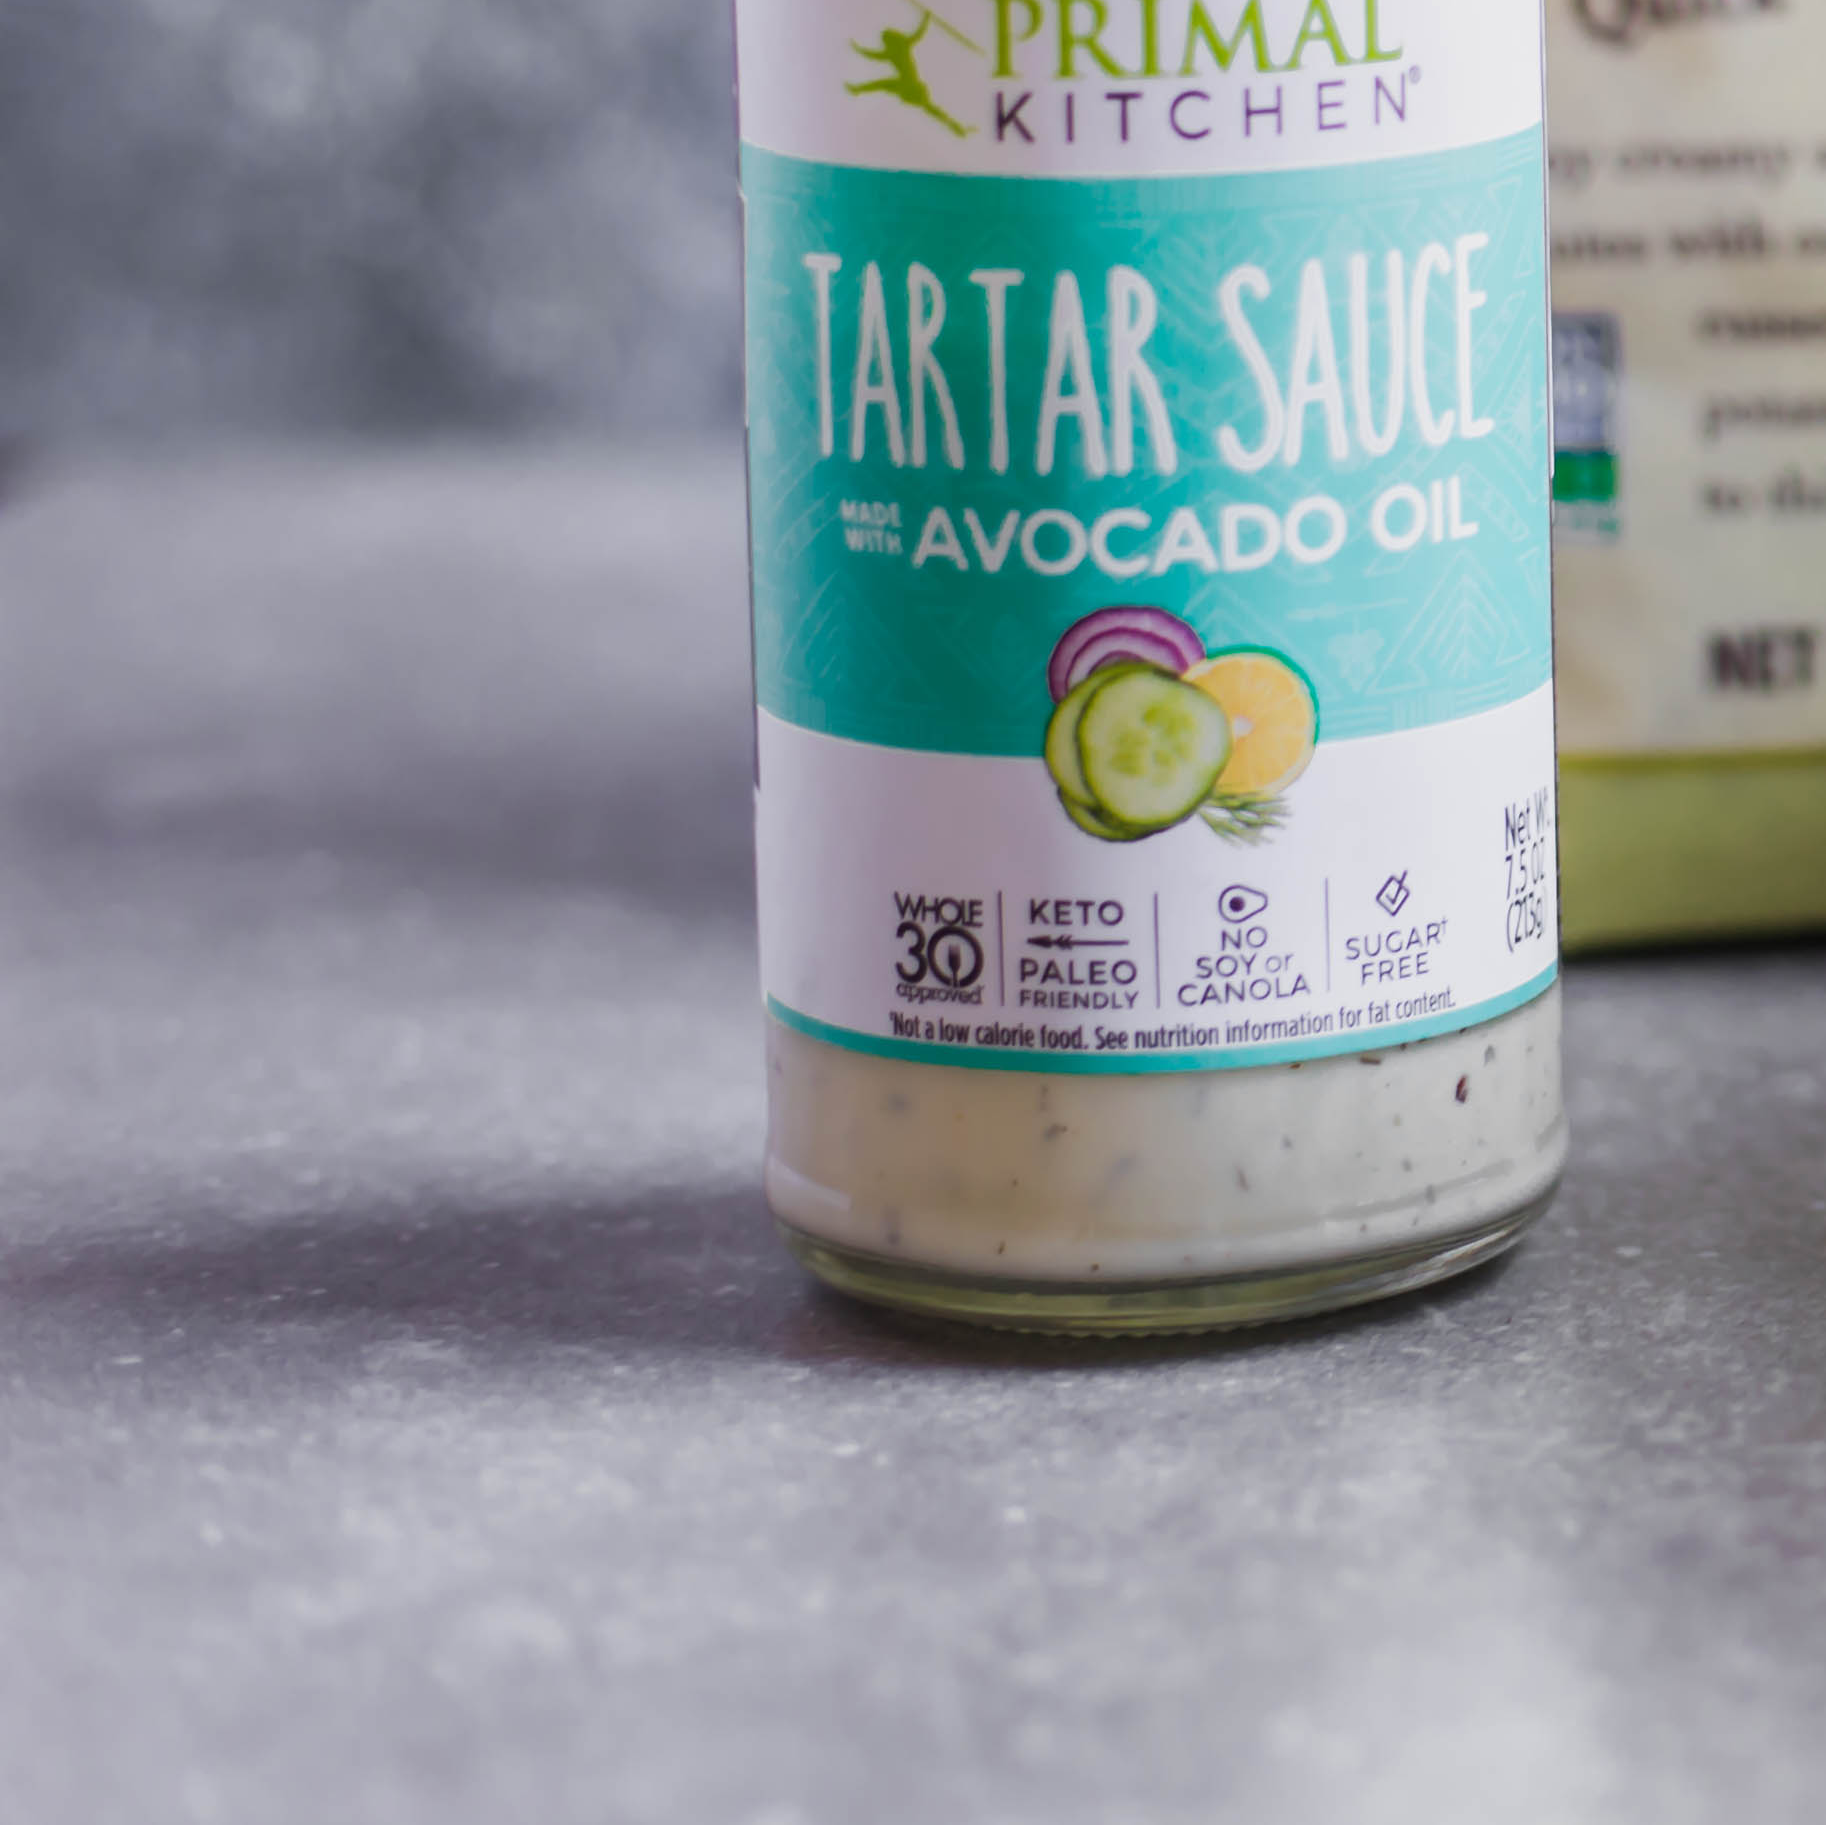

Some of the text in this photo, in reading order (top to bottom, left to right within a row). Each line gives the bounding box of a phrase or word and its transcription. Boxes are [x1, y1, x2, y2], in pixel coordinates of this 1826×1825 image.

[804, 253, 1177, 477] TARTAR
[1219, 233, 1495, 472] SAUCE
[840, 498, 903, 528] MADE
[912, 476, 1480, 576] AVOCADO OIL
[844, 527, 904, 555] WITH
[1708, 622, 1817, 692] NET
[1504, 797, 1531, 852] Net
[1504, 846, 1528, 901] 7.5
[894, 890, 984, 928] WHOLE
[1029, 898, 1125, 926] KETO
[895, 921, 985, 988] 30
[1220, 926, 1268, 951] NO
[1019, 957, 1138, 985] PALEO
[1196, 953, 1294, 980] SOY or
[1361, 952, 1430, 986] FREE
[895, 982, 986, 1006] approved
[1019, 989, 1139, 1010] FRIENDLY
[1177, 974, 1311, 1007] CANOLA
[925, 1025, 935, 1040] a
[938, 1022, 970, 1044] low
[975, 1022, 1035, 1047] calorie
[1040, 1025, 1089, 1050] food.
[1095, 1026, 1129, 1050] See
[1134, 1024, 1219, 1050] nutrition
[1226, 1012, 1334, 1044] information
[1339, 1005, 1363, 1031] for
[1368, 1001, 1392, 1025] fat
[1395, 985, 1457, 1020] content.
